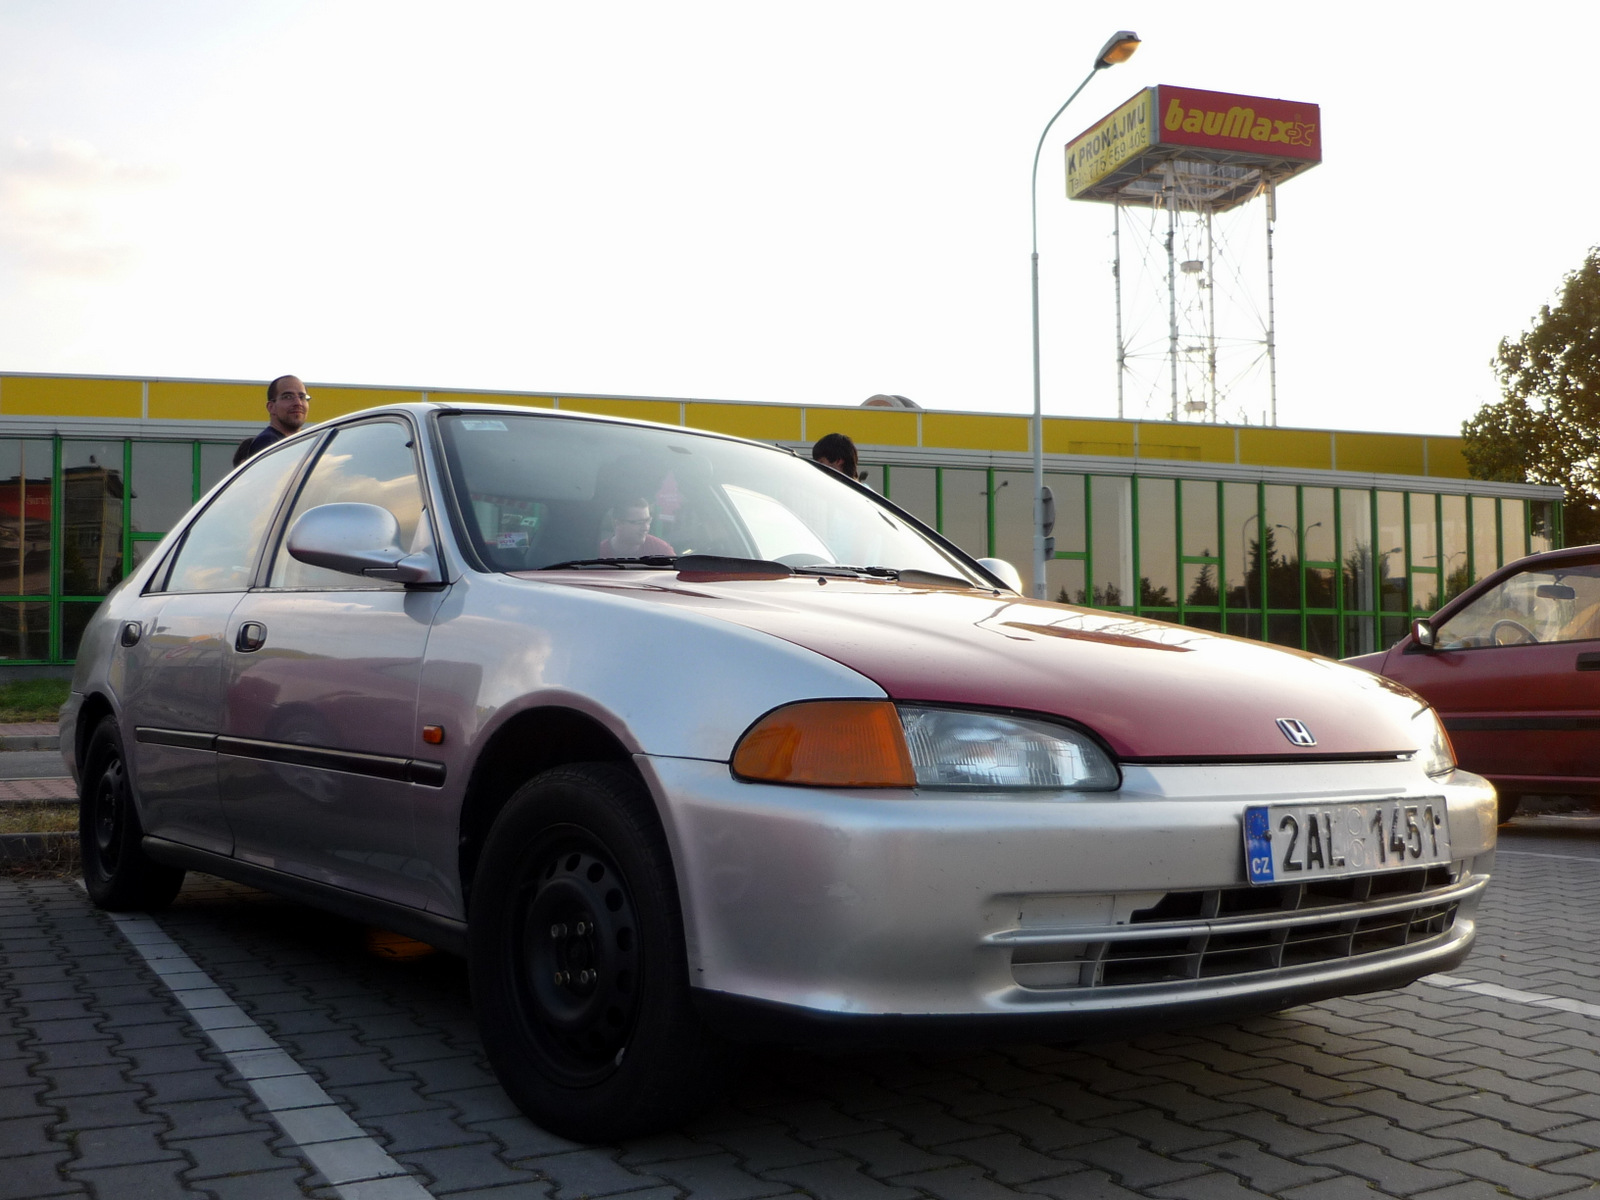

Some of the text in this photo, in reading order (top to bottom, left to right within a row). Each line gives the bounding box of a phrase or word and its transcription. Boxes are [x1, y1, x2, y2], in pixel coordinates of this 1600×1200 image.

[1068, 152, 1077, 176] K
[1279, 804, 1438, 872] 2AL 1451
[1252, 857, 1271, 875] CZ
